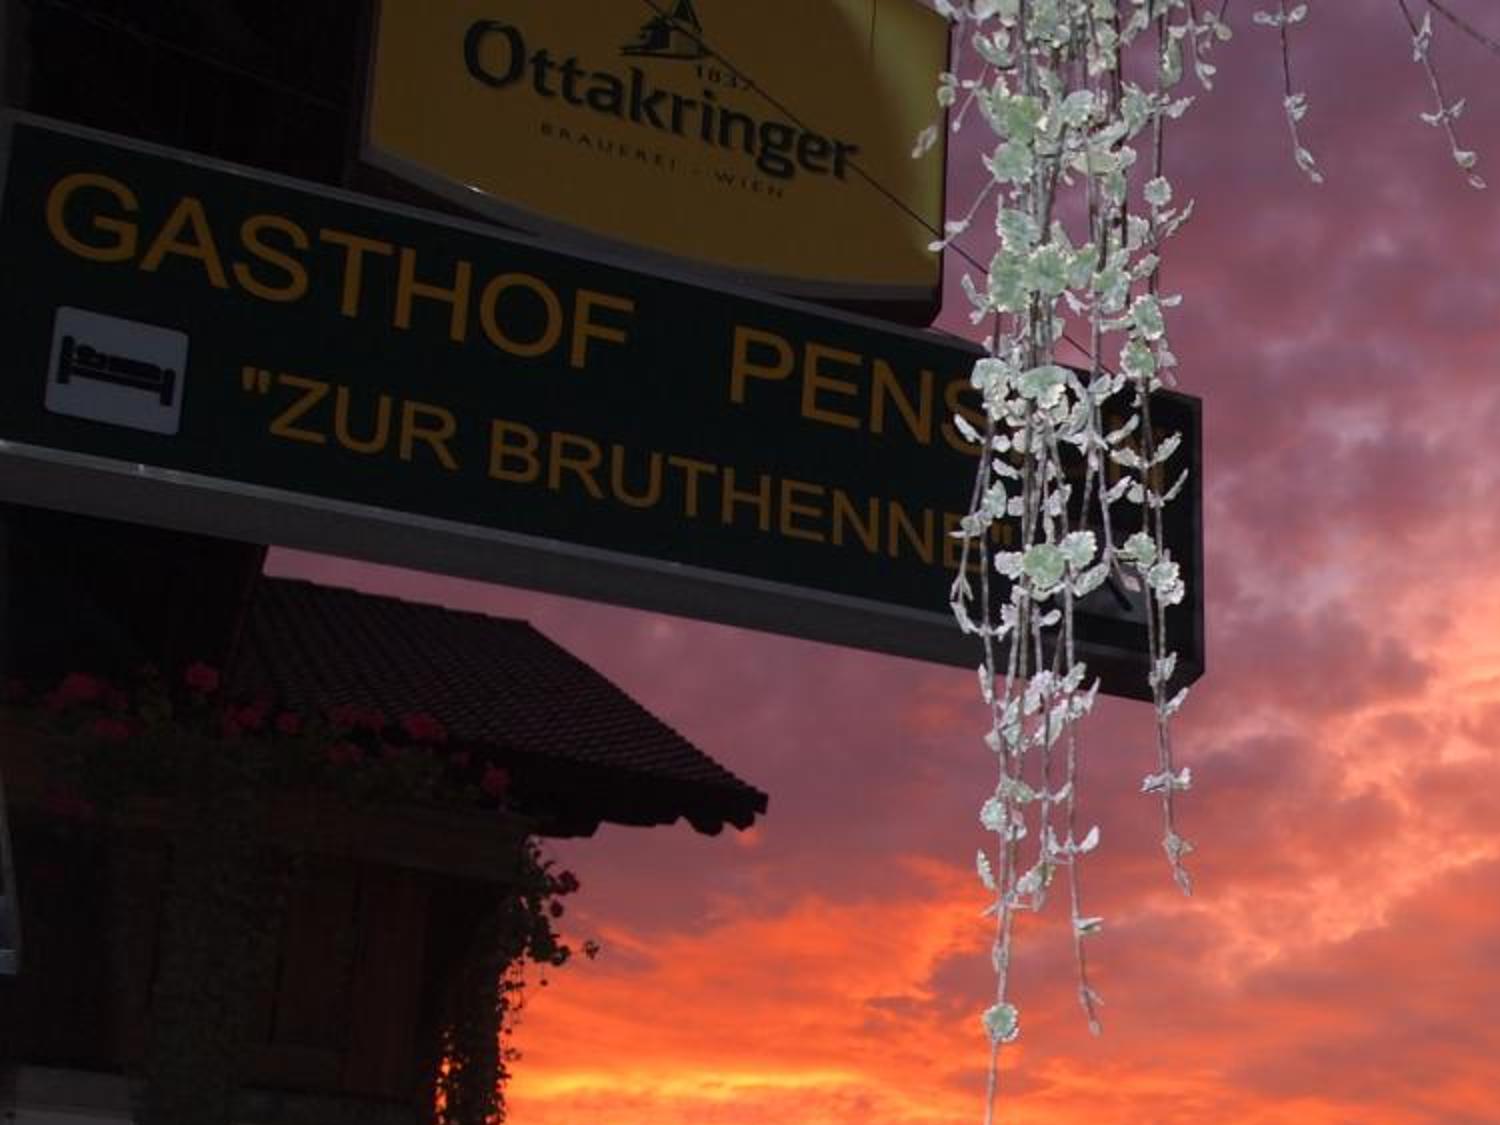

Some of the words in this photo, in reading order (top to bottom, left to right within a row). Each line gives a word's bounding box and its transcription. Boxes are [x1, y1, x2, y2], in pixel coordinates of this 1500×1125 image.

[464, 19, 859, 180] Ottakringer
[44, 171, 638, 370] GASTHOF
[239, 366, 459, 472] "ZUR
